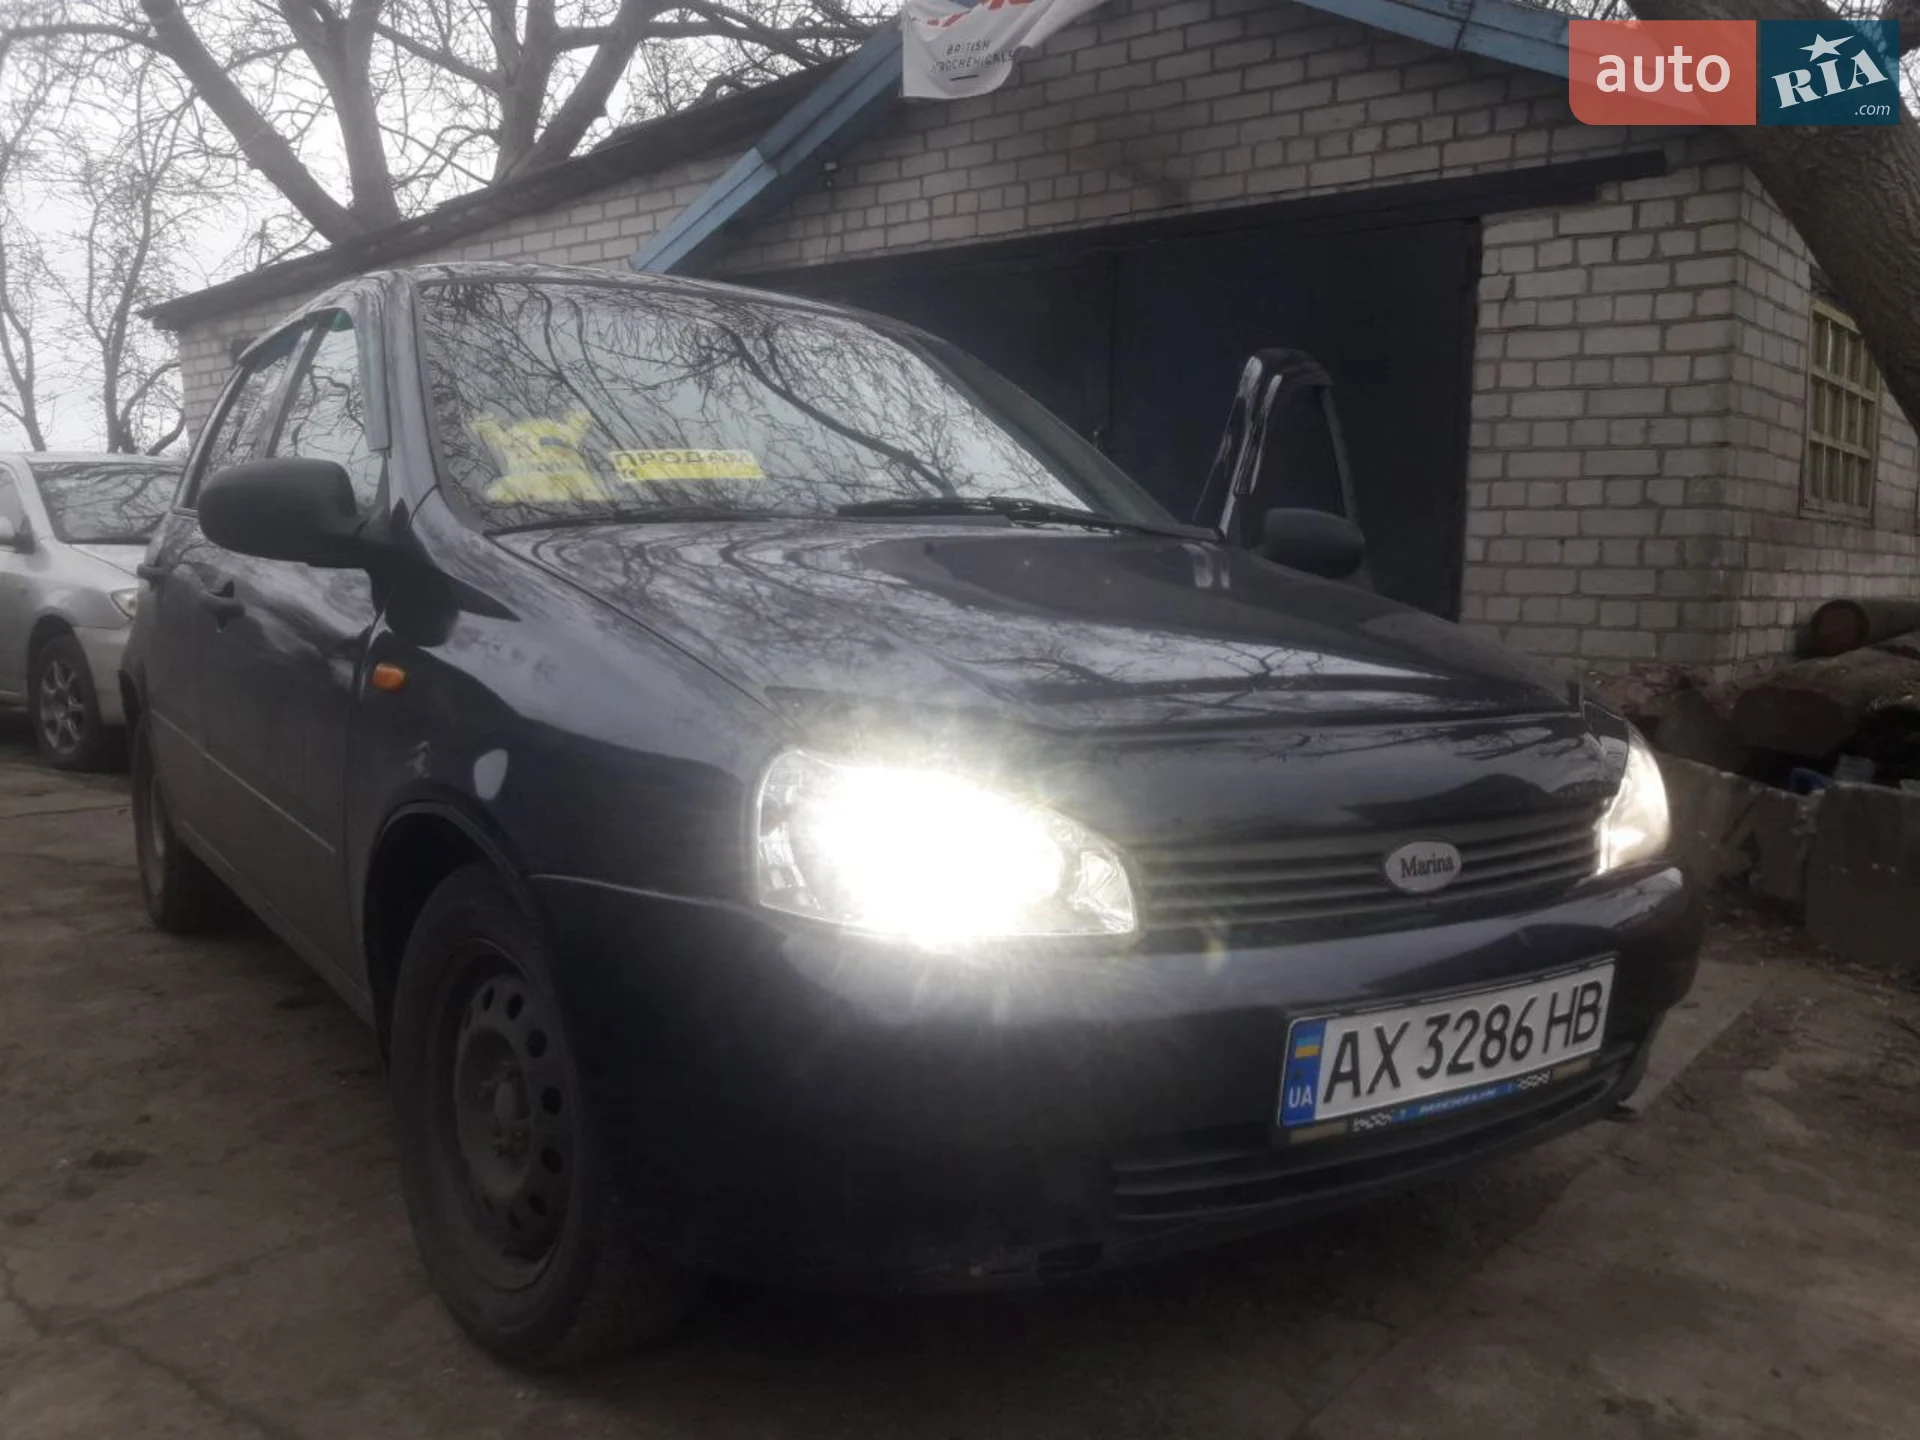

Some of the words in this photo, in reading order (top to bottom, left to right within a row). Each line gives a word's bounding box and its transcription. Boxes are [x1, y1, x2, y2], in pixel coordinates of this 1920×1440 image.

[946, 38, 990, 56] BRITISH
[1401, 852, 1454, 878] Marina
[1322, 1020, 1412, 1104] AX
[1416, 997, 1538, 1080] 3286
[1543, 981, 1603, 1055] HB
[1288, 1087, 1313, 1109] UA
